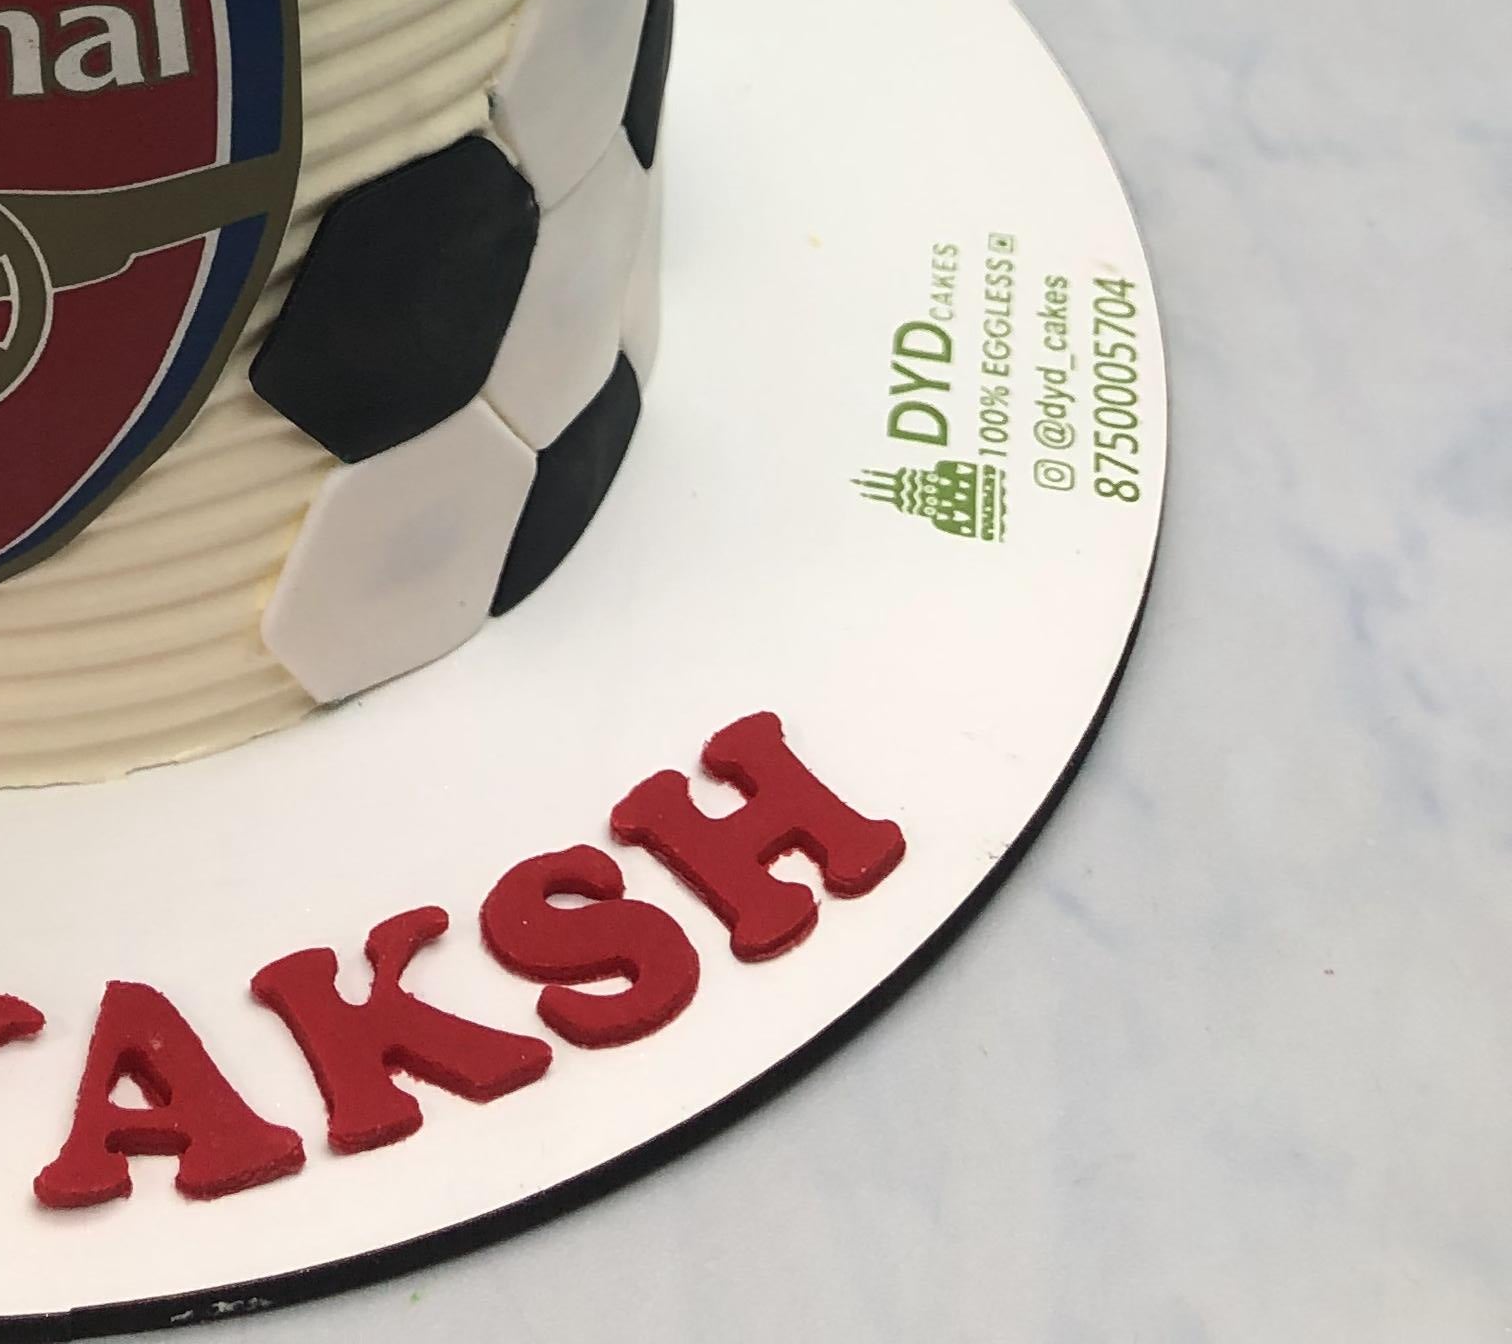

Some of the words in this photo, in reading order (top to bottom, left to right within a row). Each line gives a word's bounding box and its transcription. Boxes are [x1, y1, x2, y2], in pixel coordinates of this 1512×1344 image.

[886, 319, 953, 447] DYD
[928, 241, 959, 321] CAKES
[981, 258, 1015, 378] EGGLESS
[1032, 274, 1077, 450] @dyd_cakes
[1092, 276, 1141, 503] 8750005704
[977, 385, 1010, 457] 100%
